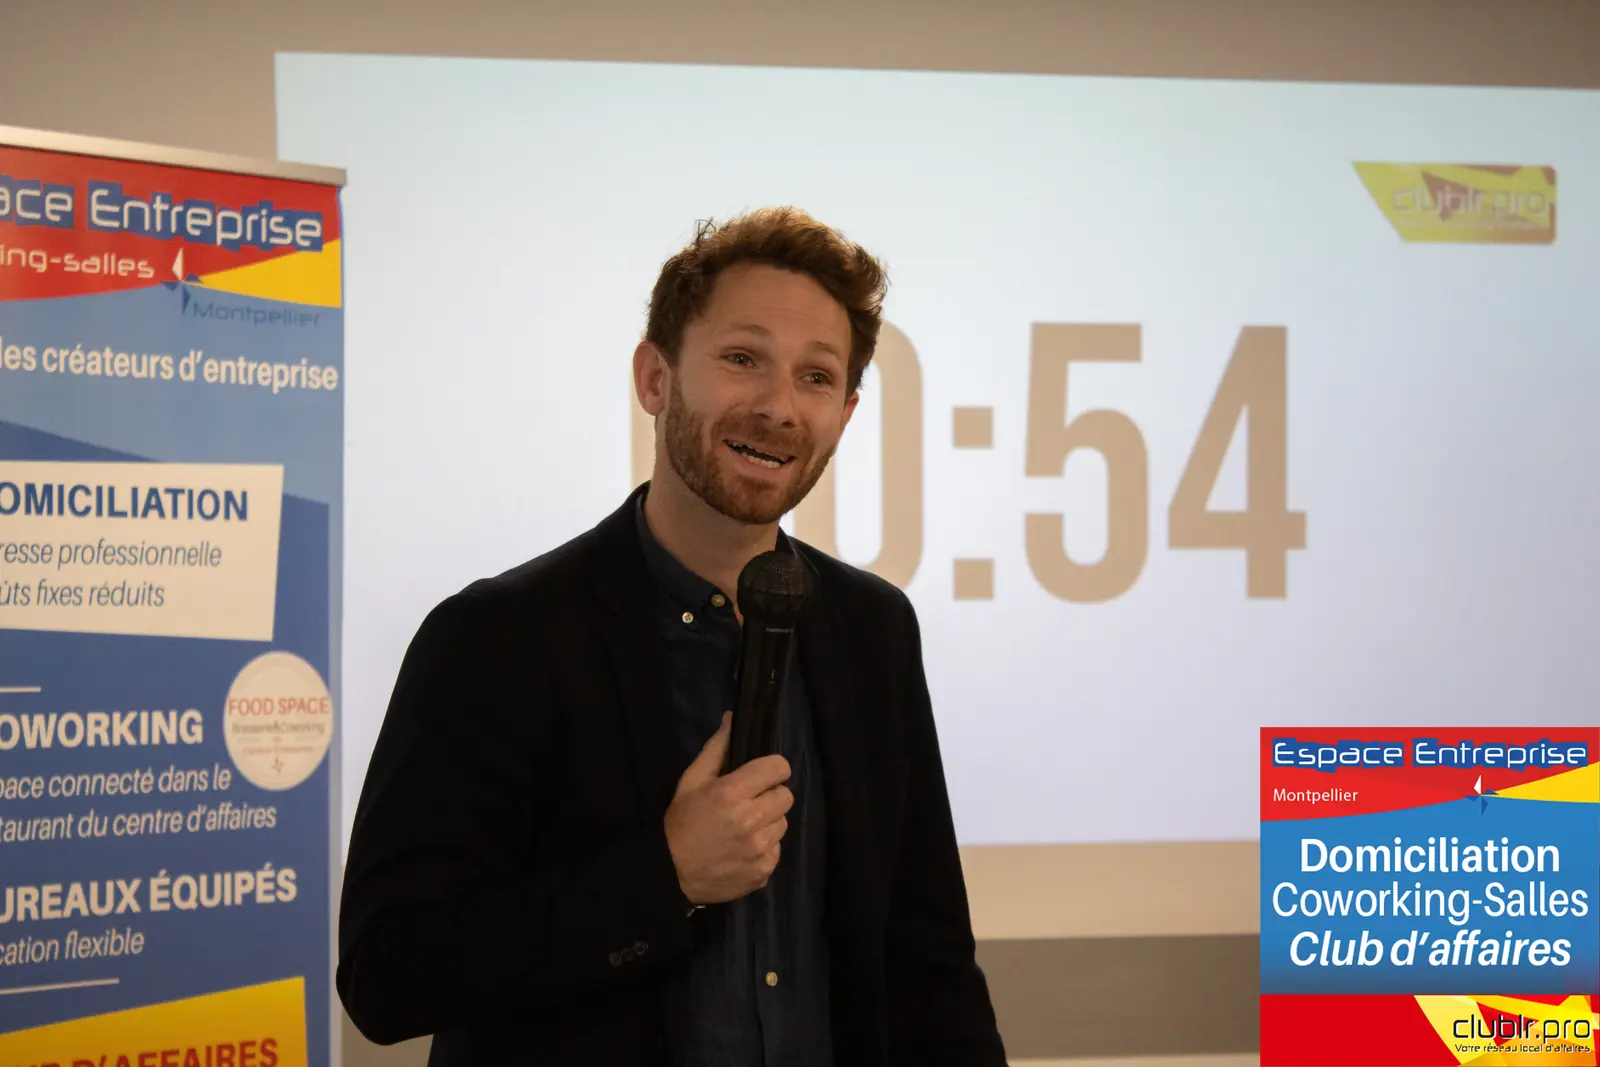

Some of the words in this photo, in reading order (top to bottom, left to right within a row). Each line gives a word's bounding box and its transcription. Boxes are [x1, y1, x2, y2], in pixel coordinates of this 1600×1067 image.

[91, 189, 322, 247] Entreprise
[193, 301, 320, 327] Montpellier
[43, 344, 174, 380] créateurs
[179, 350, 338, 394] d'entreprise
[0, 481, 248, 522] OMICILIATION
[57, 538, 222, 570] professionnelle
[37, 578, 83, 607] fixes
[88, 580, 165, 607] réduits
[228, 697, 274, 717] FOOD
[278, 695, 330, 716] SPACE
[0, 708, 203, 750] OWORKING
[49, 766, 154, 798] connecté
[158, 764, 208, 794] dans
[213, 763, 231, 791] le
[78, 809, 109, 838] du
[113, 808, 183, 836] centre
[187, 801, 277, 833] d'affaires
[150, 862, 297, 912] ÉQUIPÉS
[65, 926, 145, 960] flexible
